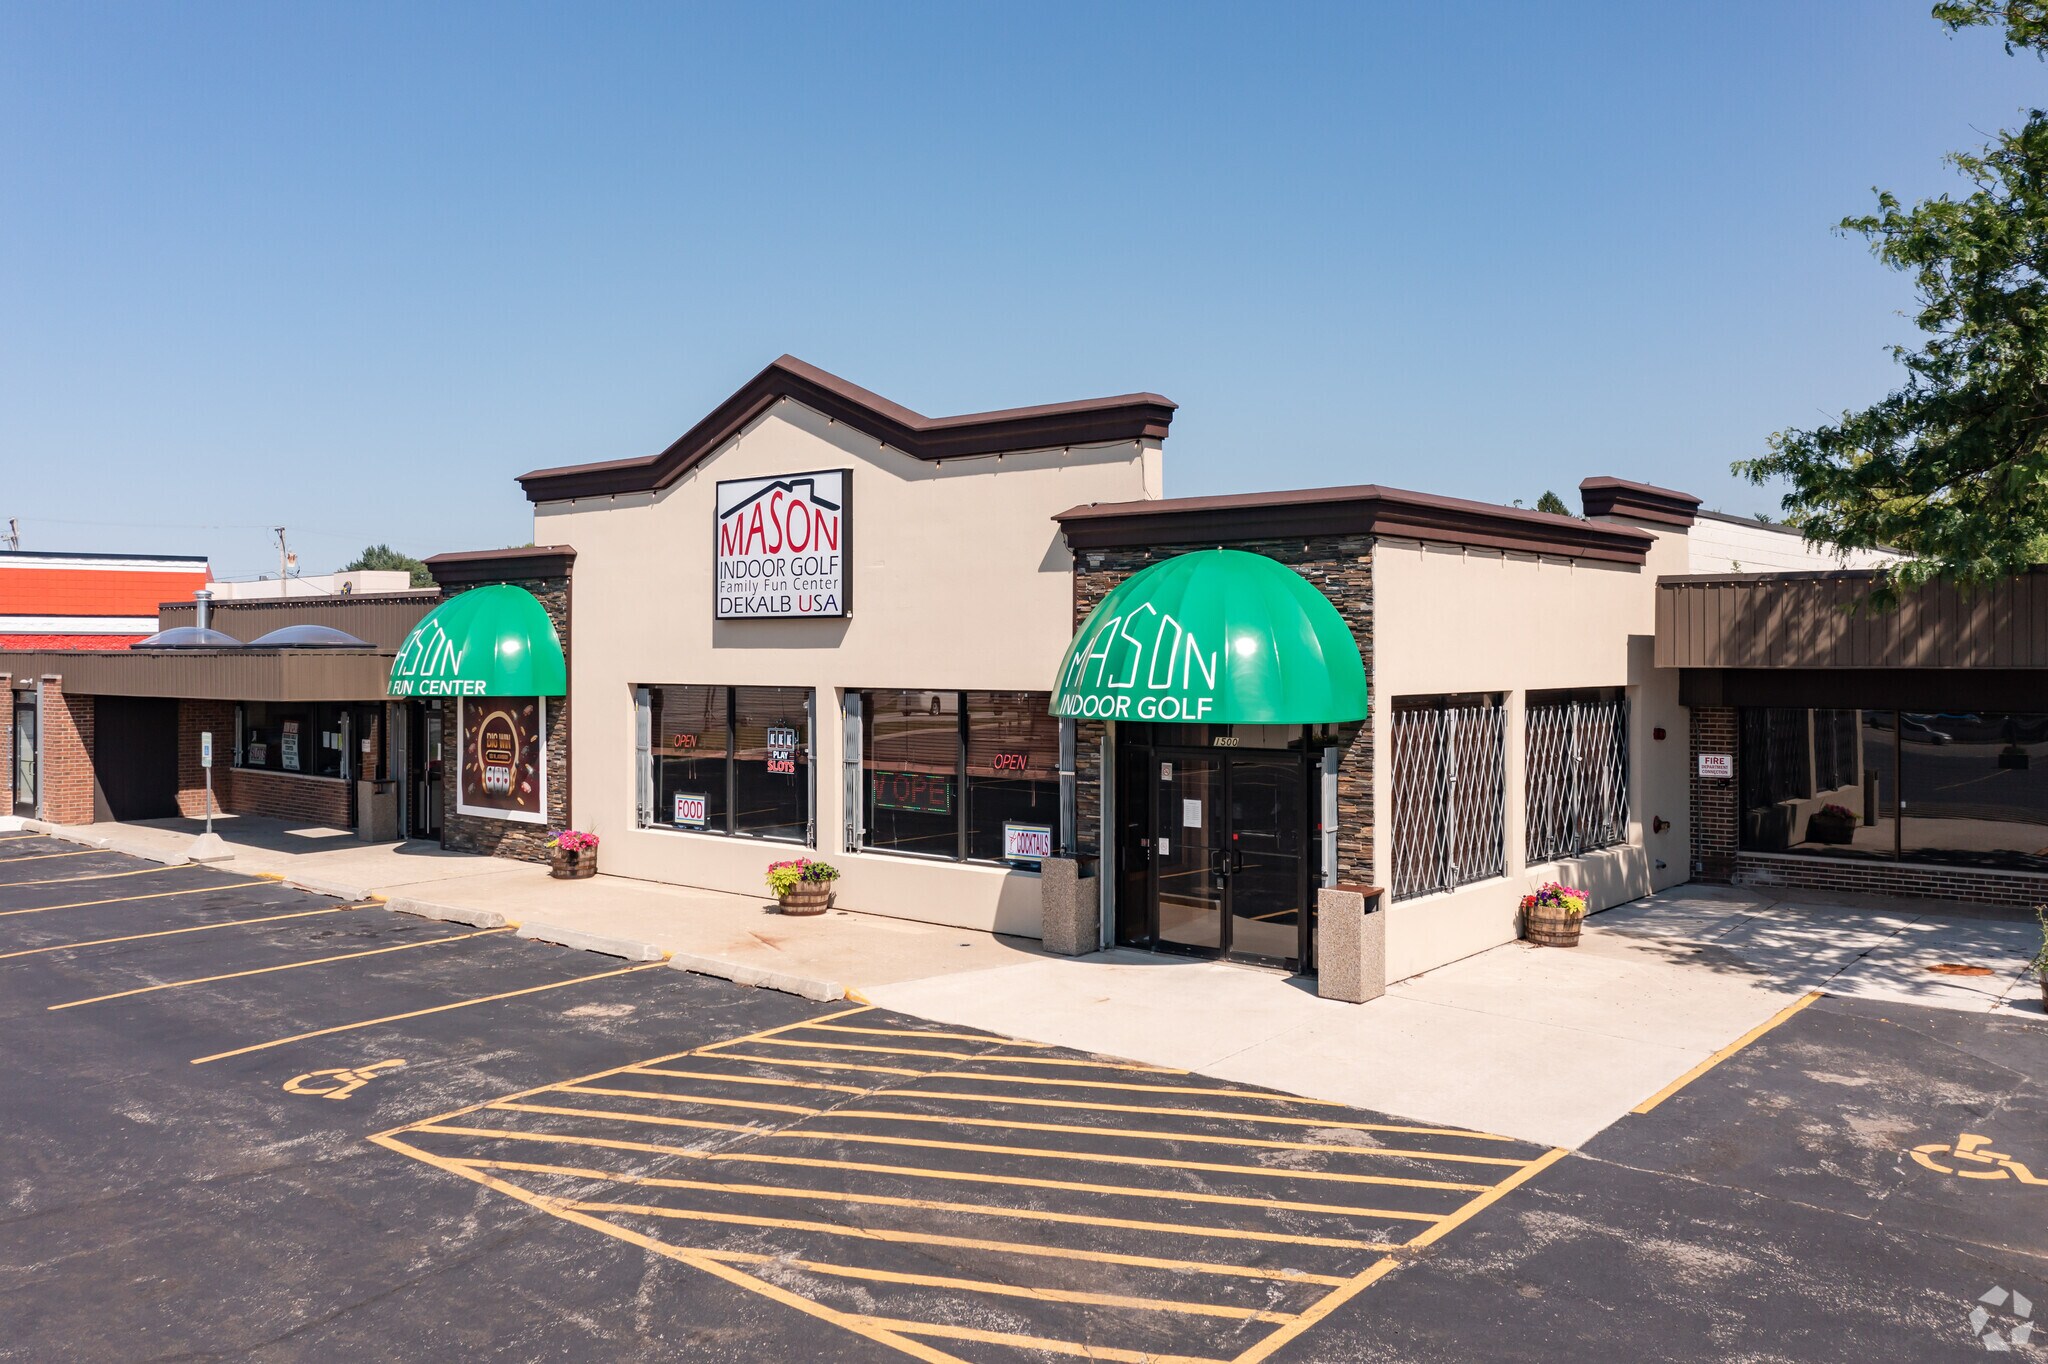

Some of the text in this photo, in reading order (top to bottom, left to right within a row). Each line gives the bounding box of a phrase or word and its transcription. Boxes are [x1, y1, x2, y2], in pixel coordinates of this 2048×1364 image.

[720, 490, 838, 557] MASON
[720, 556, 839, 579] INDOOR GOLF
[720, 577, 839, 595] Family Fun Center
[720, 594, 839, 614] DEKALB USA
[390, 618, 463, 677] ASON
[1065, 602, 1217, 690] MASON
[392, 680, 414, 695] FUN
[419, 680, 487, 695] CENTER
[1059, 694, 1214, 720] INDOOR GOLF
[674, 734, 698, 748] OPEN
[1215, 737, 1238, 746] 1500
[773, 750, 789, 759] PLAY
[993, 754, 1027, 770] OPEN
[767, 760, 795, 773] SLOTS
[677, 799, 703, 819] FOOD
[1016, 832, 1049, 856] COCKTAILS
